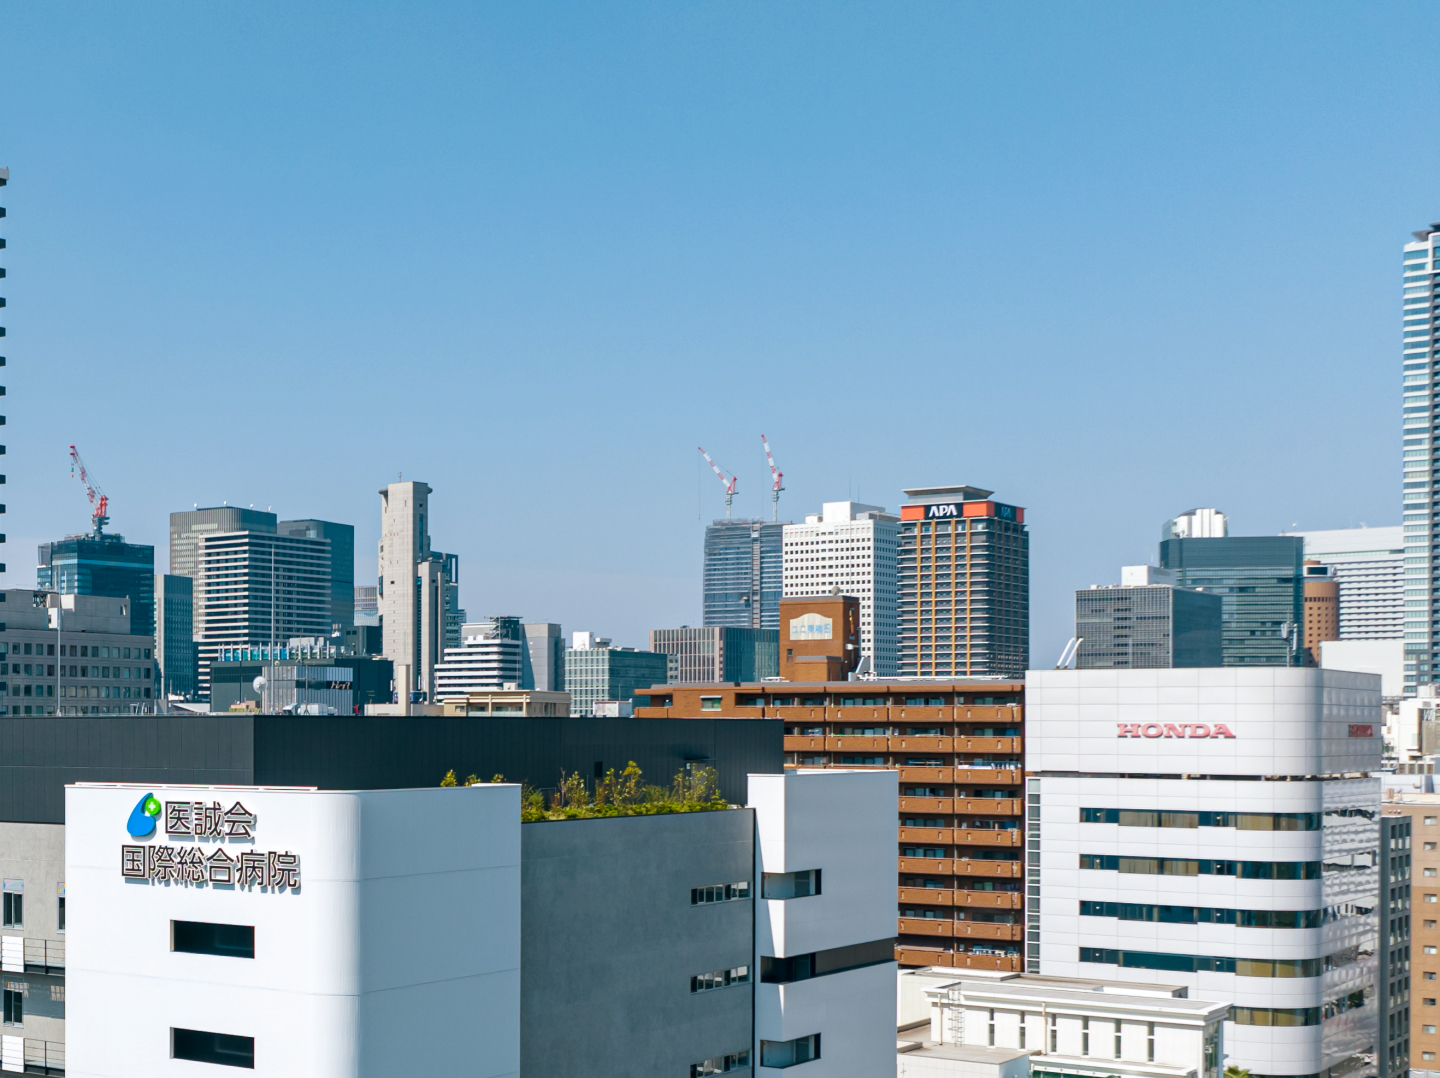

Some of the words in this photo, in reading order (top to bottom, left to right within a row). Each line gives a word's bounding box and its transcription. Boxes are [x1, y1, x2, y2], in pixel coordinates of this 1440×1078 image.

[929, 504, 958, 517] APA
[1116, 723, 1236, 738] HONDA
[165, 801, 253, 838] 医誠会
[122, 845, 297, 888] 国際総合病院
